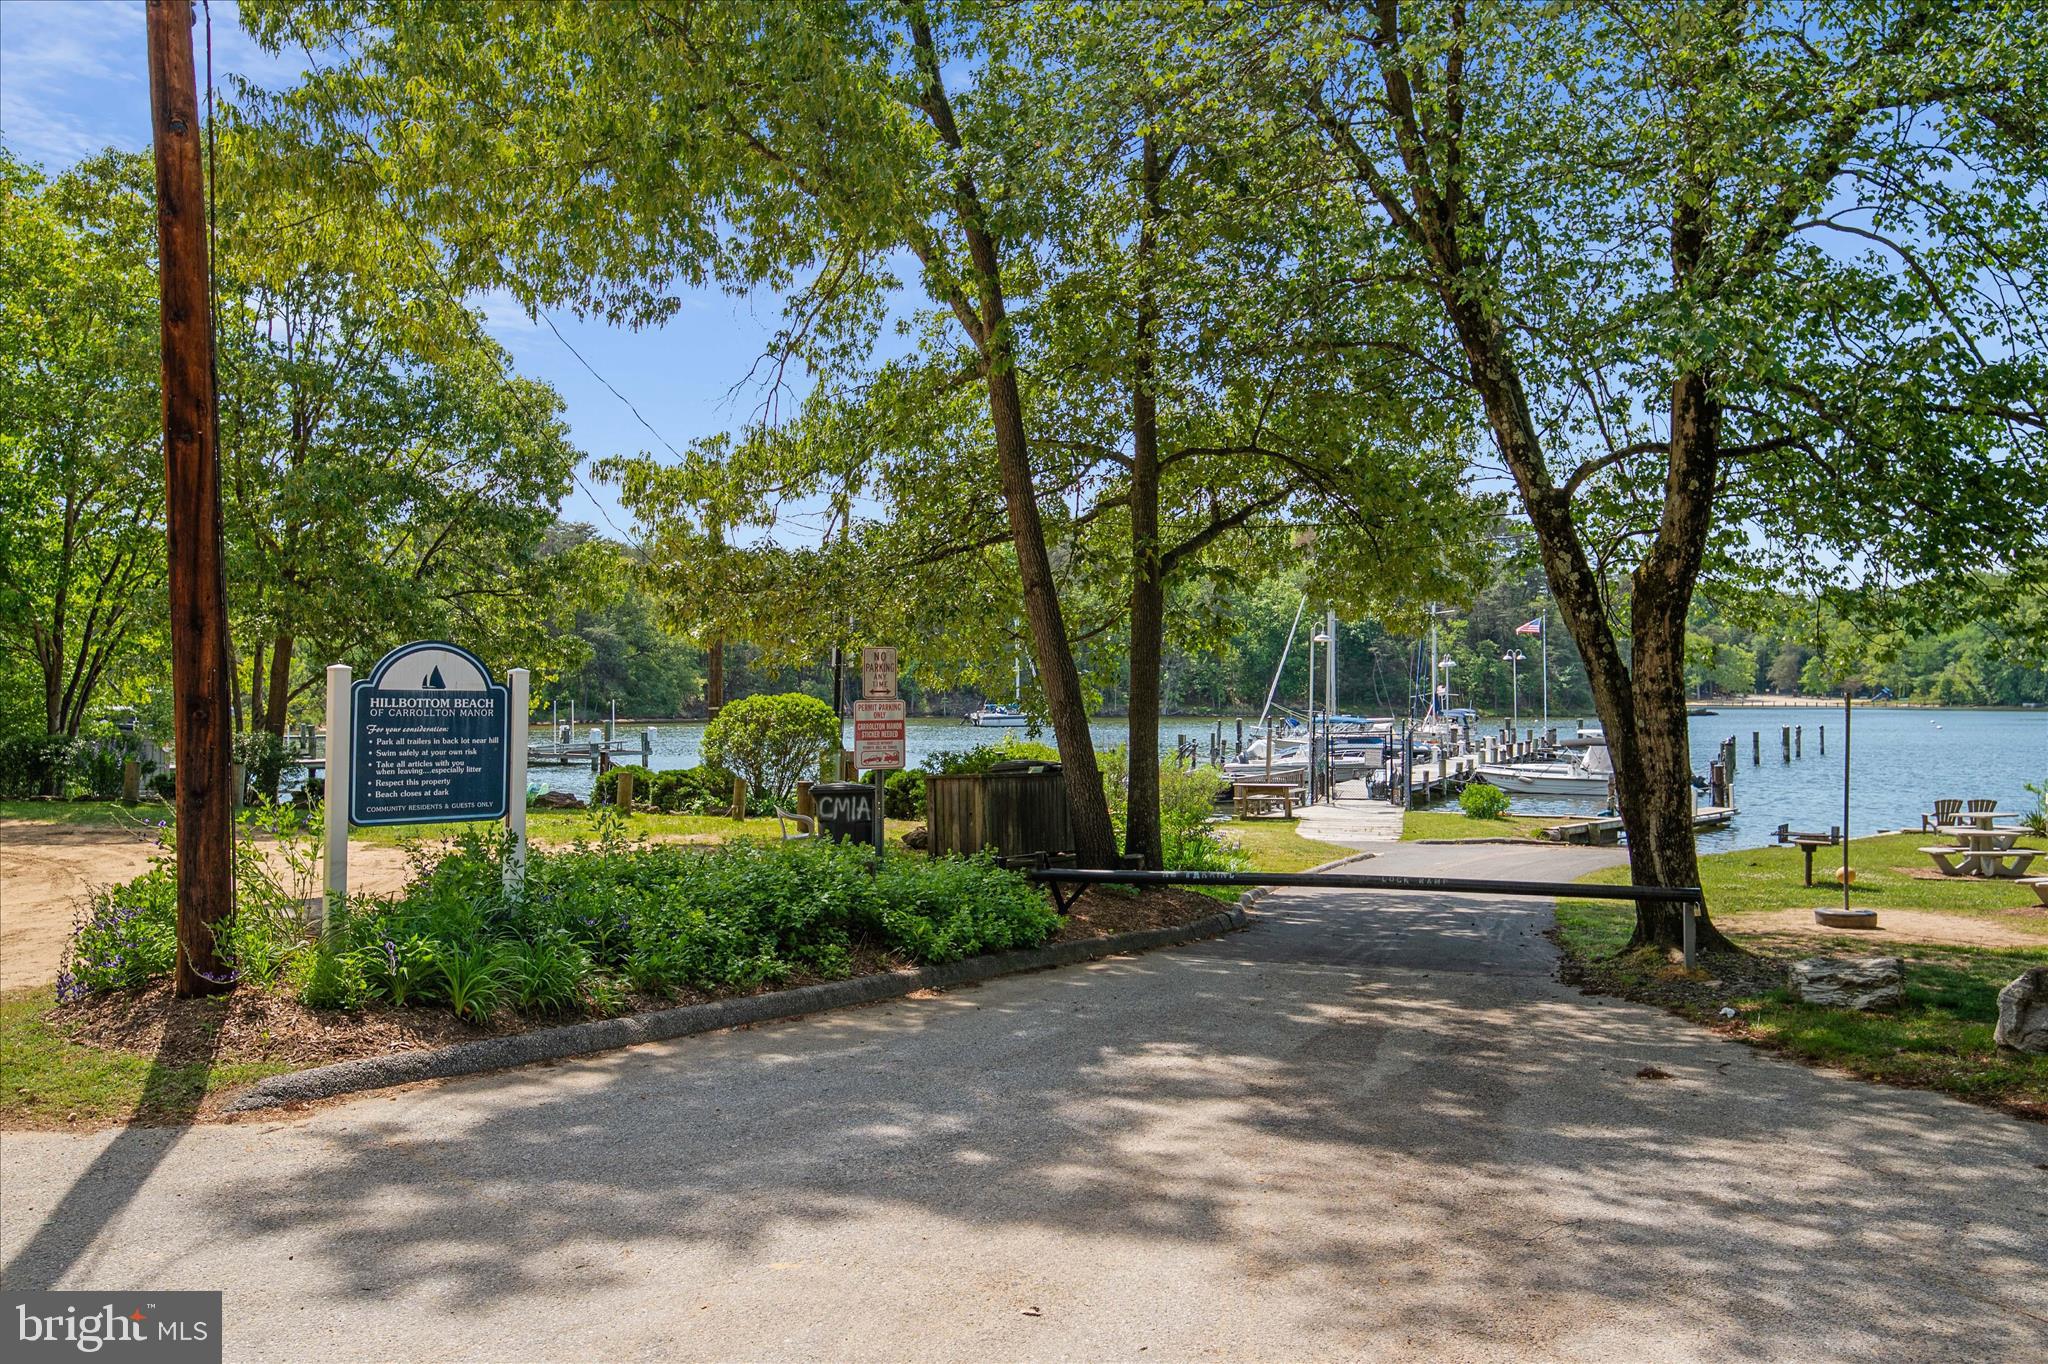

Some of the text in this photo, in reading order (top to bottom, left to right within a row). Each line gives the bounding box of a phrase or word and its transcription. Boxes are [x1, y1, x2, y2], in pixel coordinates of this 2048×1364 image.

[874, 652, 886, 661] NO
[866, 663, 894, 672] PARKING
[370, 698, 494, 708] HILLBOTTOM BEACH
[366, 724, 384, 734] For
[402, 725, 449, 733] consideration:
[399, 749, 419, 758] safely
[366, 805, 406, 813] COMMUNITY
[819, 796, 871, 821] CMIA
